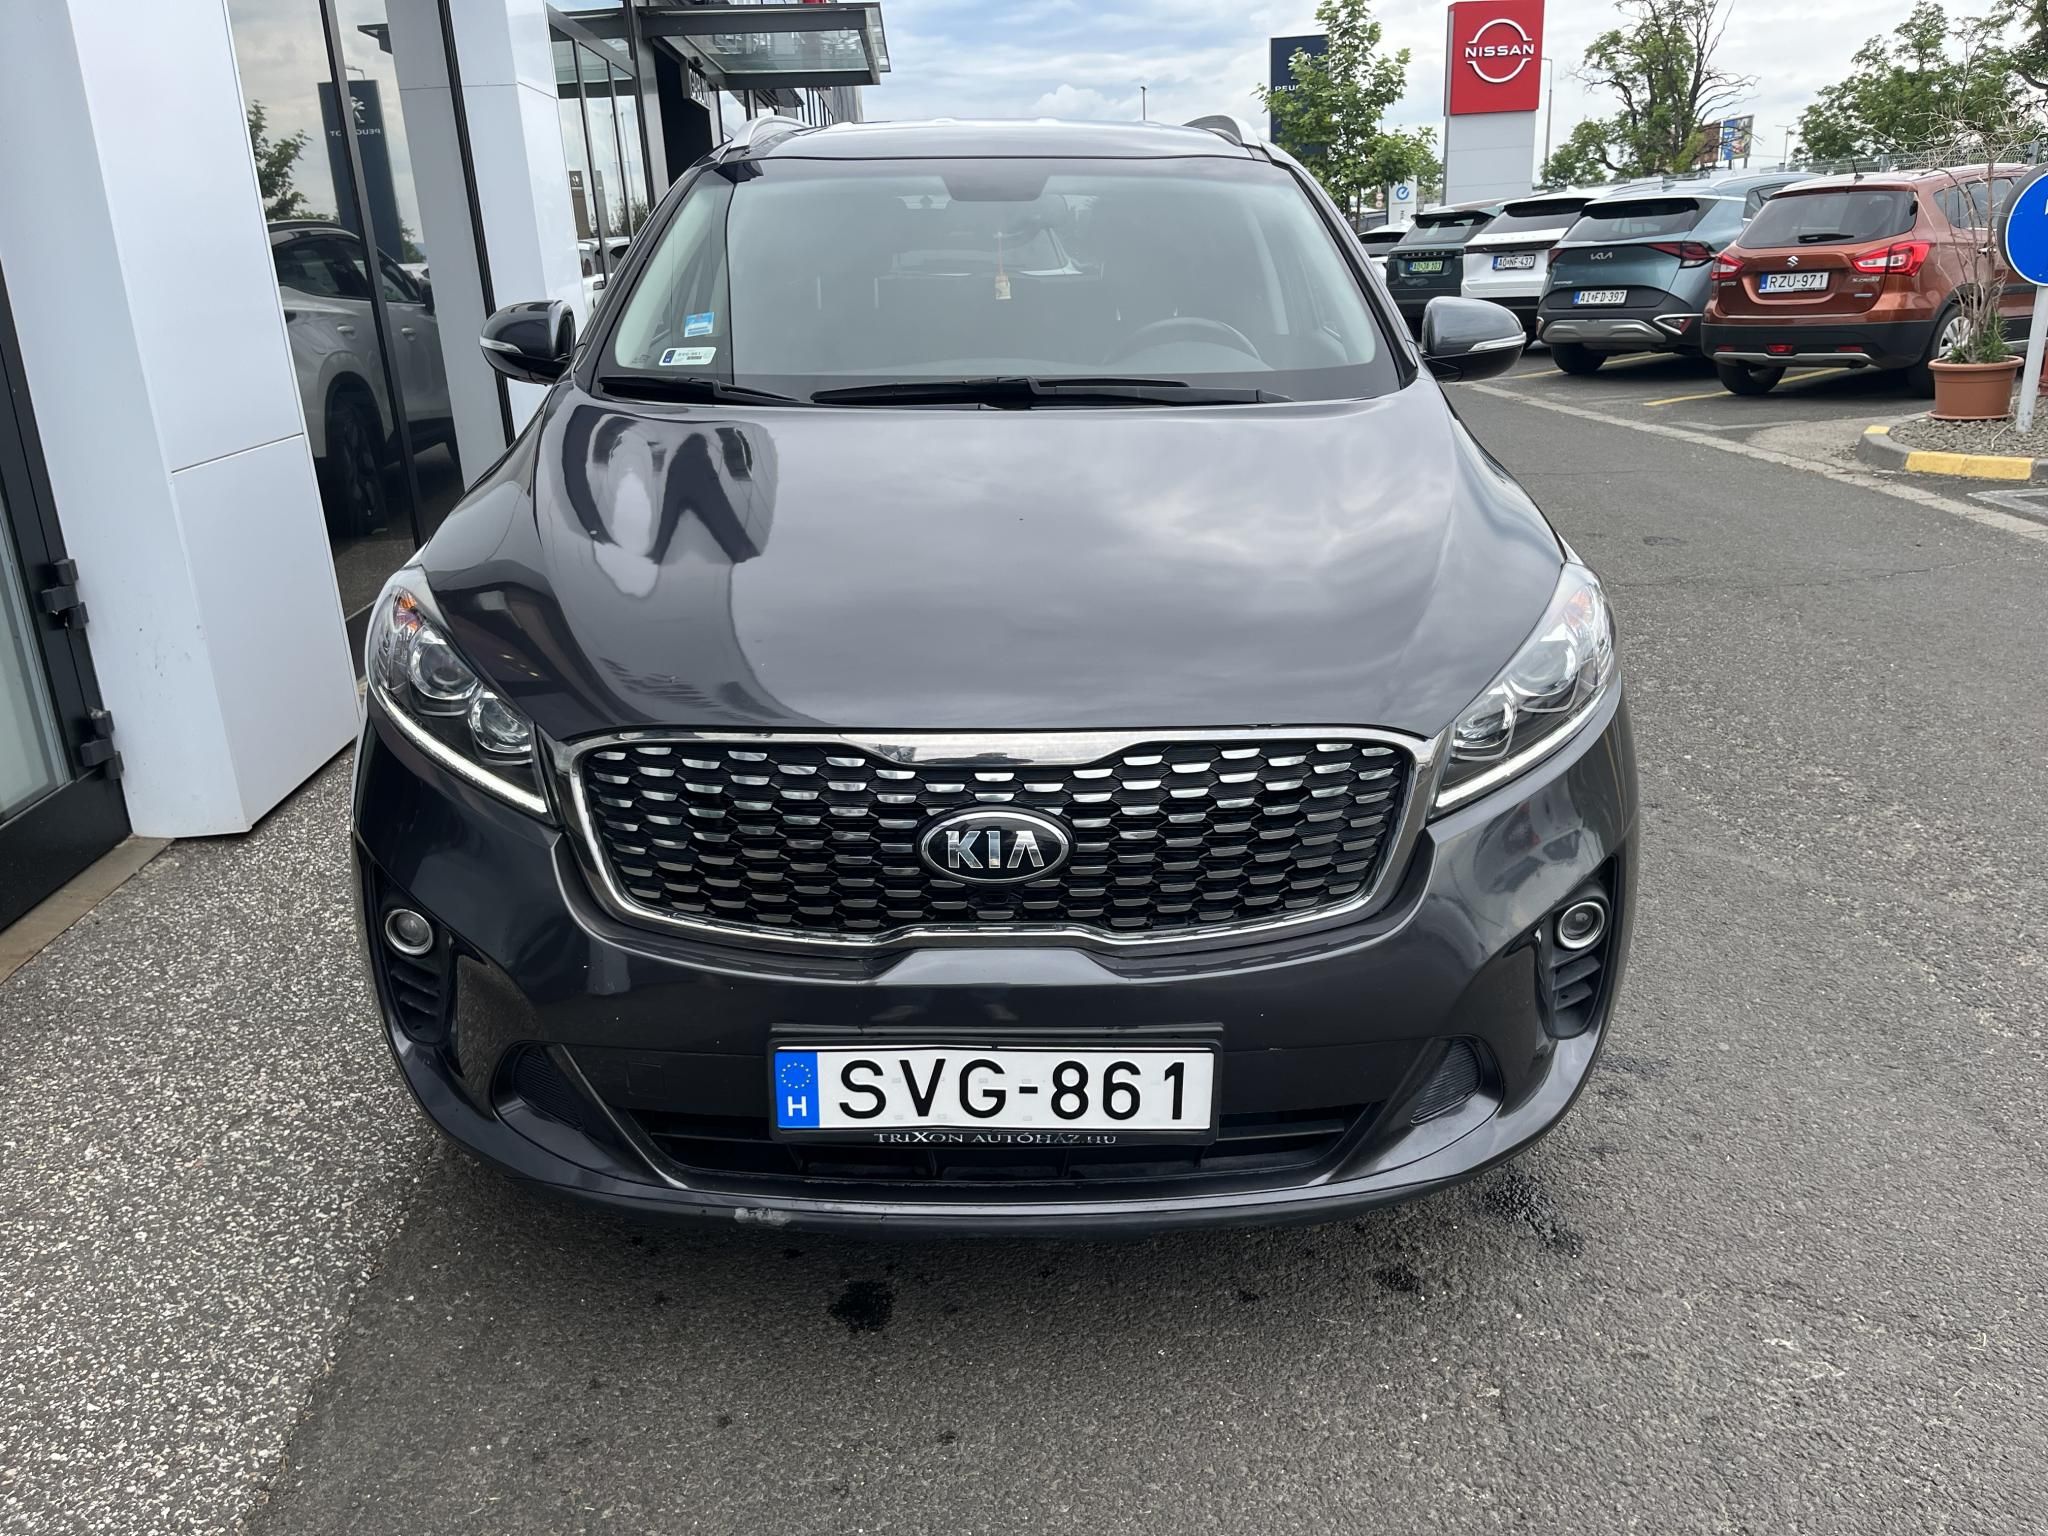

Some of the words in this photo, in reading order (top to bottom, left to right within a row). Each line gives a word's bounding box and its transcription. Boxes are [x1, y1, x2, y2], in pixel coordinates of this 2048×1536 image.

[1465, 44, 1534, 58] NISSAN
[1590, 251, 1613, 260] KIA
[1769, 274, 1824, 289] RZU-971
[945, 830, 1045, 869] KIA
[839, 1058, 1185, 1121] SVG-861
[787, 1096, 807, 1117] H
